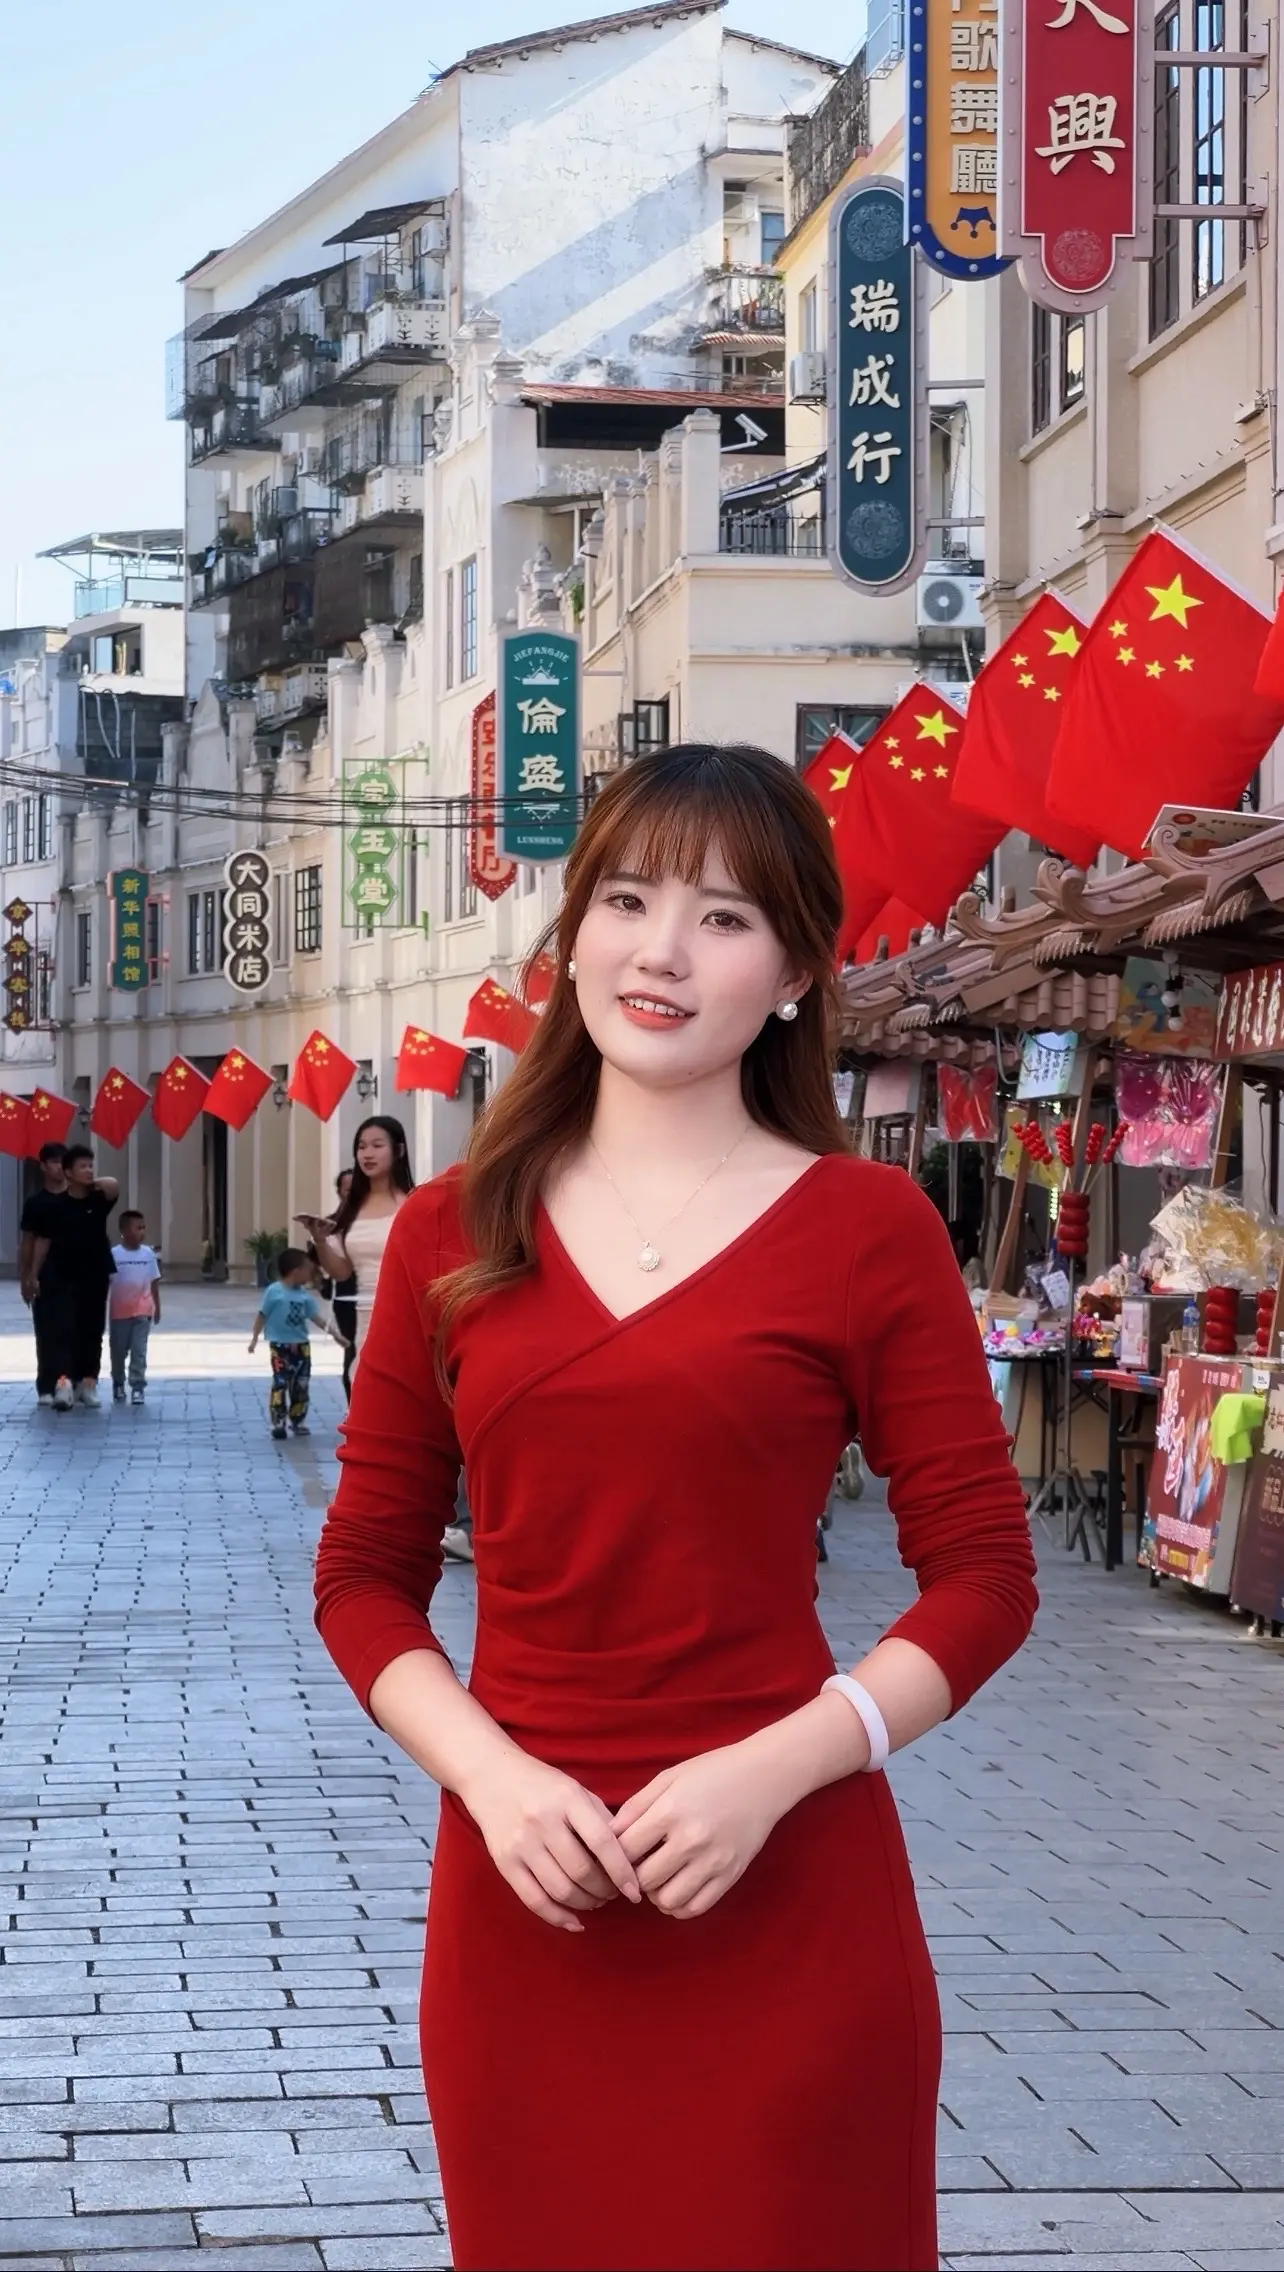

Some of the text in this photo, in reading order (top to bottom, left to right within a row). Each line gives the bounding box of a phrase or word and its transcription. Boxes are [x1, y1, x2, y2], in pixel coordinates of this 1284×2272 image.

[950, 0, 998, 194] 歌舞廳
[846, 279, 902, 485] 瑞成行
[513, 646, 570, 663] JIEFANGJIE
[516, 697, 567, 793] 倫盛
[516, 836, 564, 846] LUNSHENG
[121, 878, 141, 982] 新华照相馆
[236, 860, 263, 984] 大同米店
